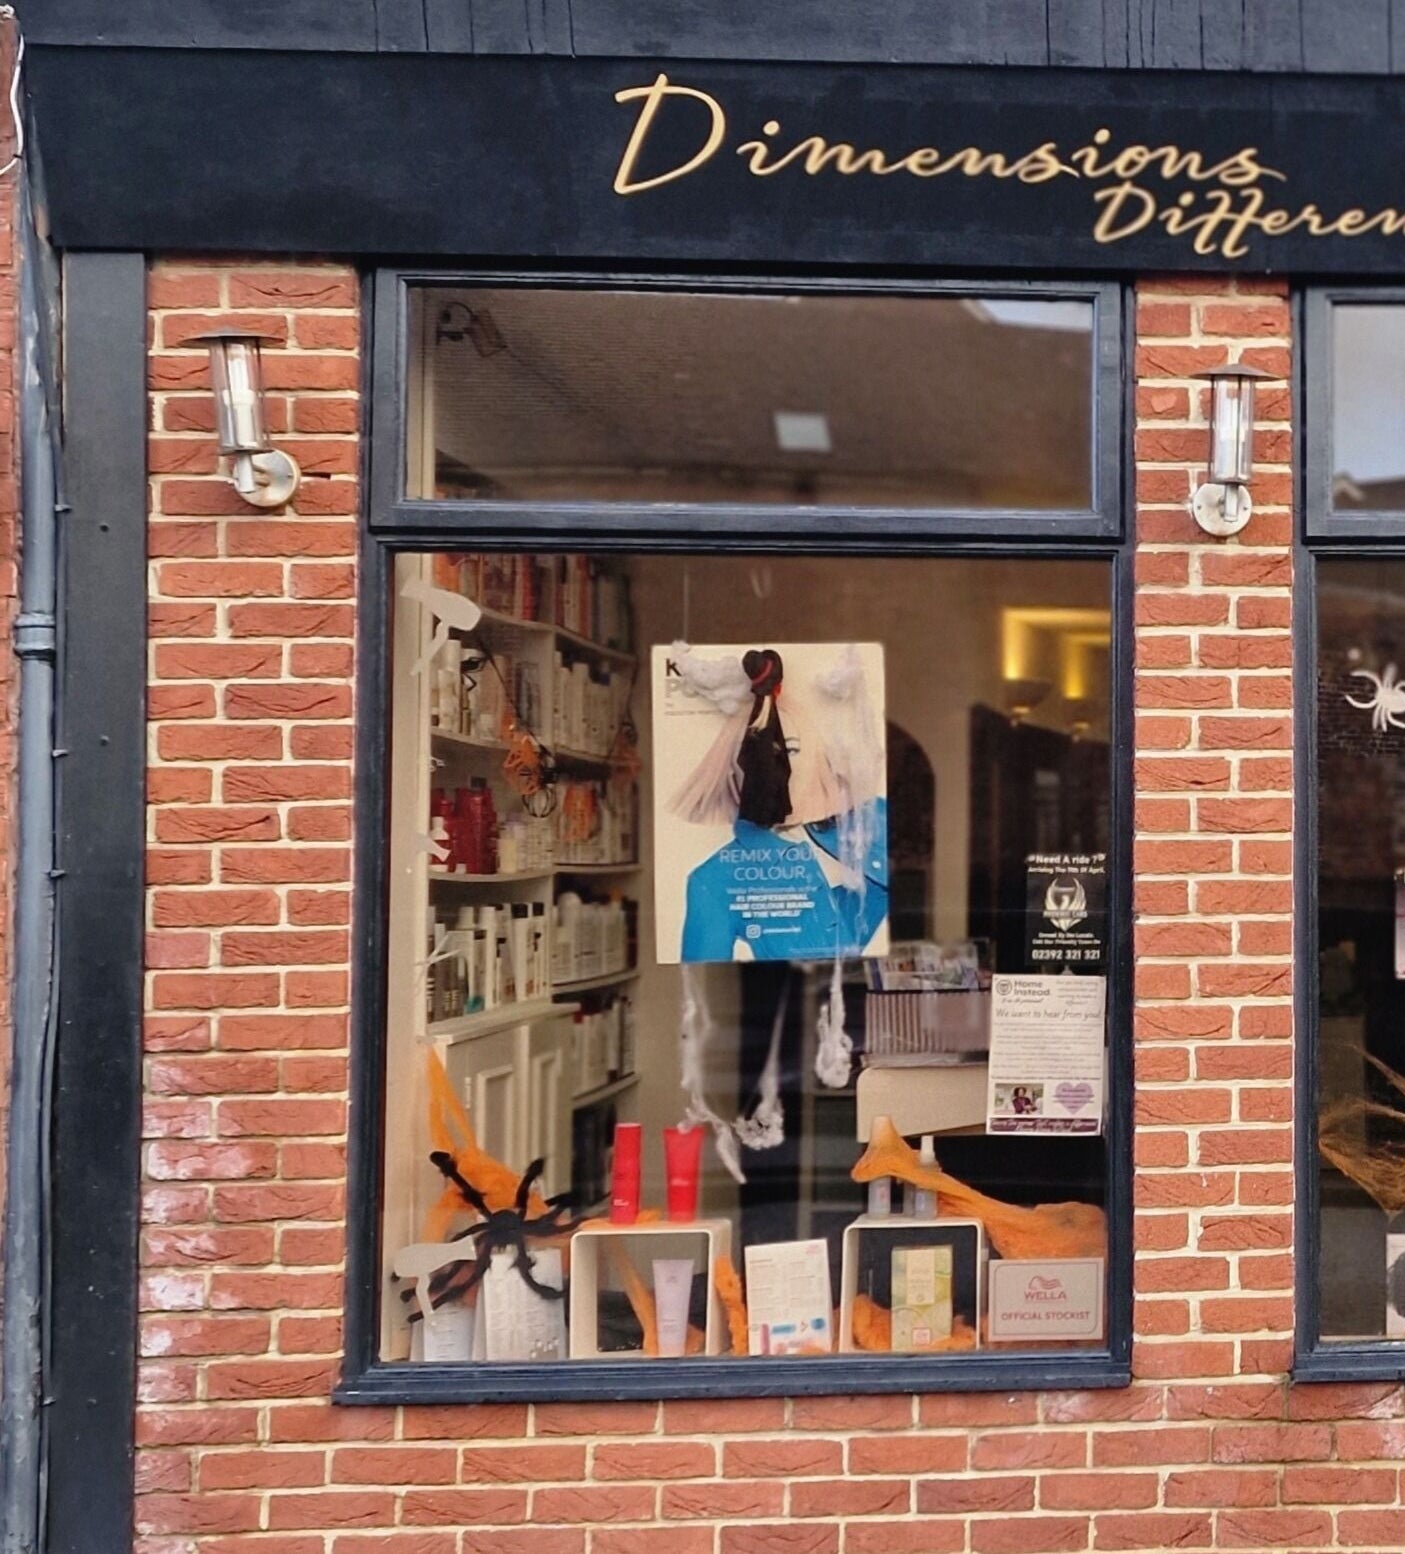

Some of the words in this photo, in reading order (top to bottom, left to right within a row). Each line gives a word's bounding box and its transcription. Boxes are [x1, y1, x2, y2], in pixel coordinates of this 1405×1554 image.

[613, 73, 1287, 195] Dimensions
[719, 849, 772, 863] REMIX
[1035, 854, 1061, 865] Need
[1062, 855, 1071, 864] A
[1072, 854, 1090, 865] ride
[1031, 949, 1063, 960] 02392
[1064, 949, 1082, 960] 321
[1083, 949, 1101, 960] 321
[1014, 980, 1043, 988] Home
[1014, 988, 1051, 997] Instead
[995, 1008, 1009, 1017] We
[1011, 1010, 1031, 1018] want
[1033, 1010, 1042, 1018] to
[1043, 1009, 1060, 1018] hear
[1061, 1009, 1081, 1021] from
[1023, 1290, 1067, 1300] WELLA
[1001, 1311, 1042, 1321] OFFICIAL
[1045, 1310, 1090, 1321] STOCKIST
